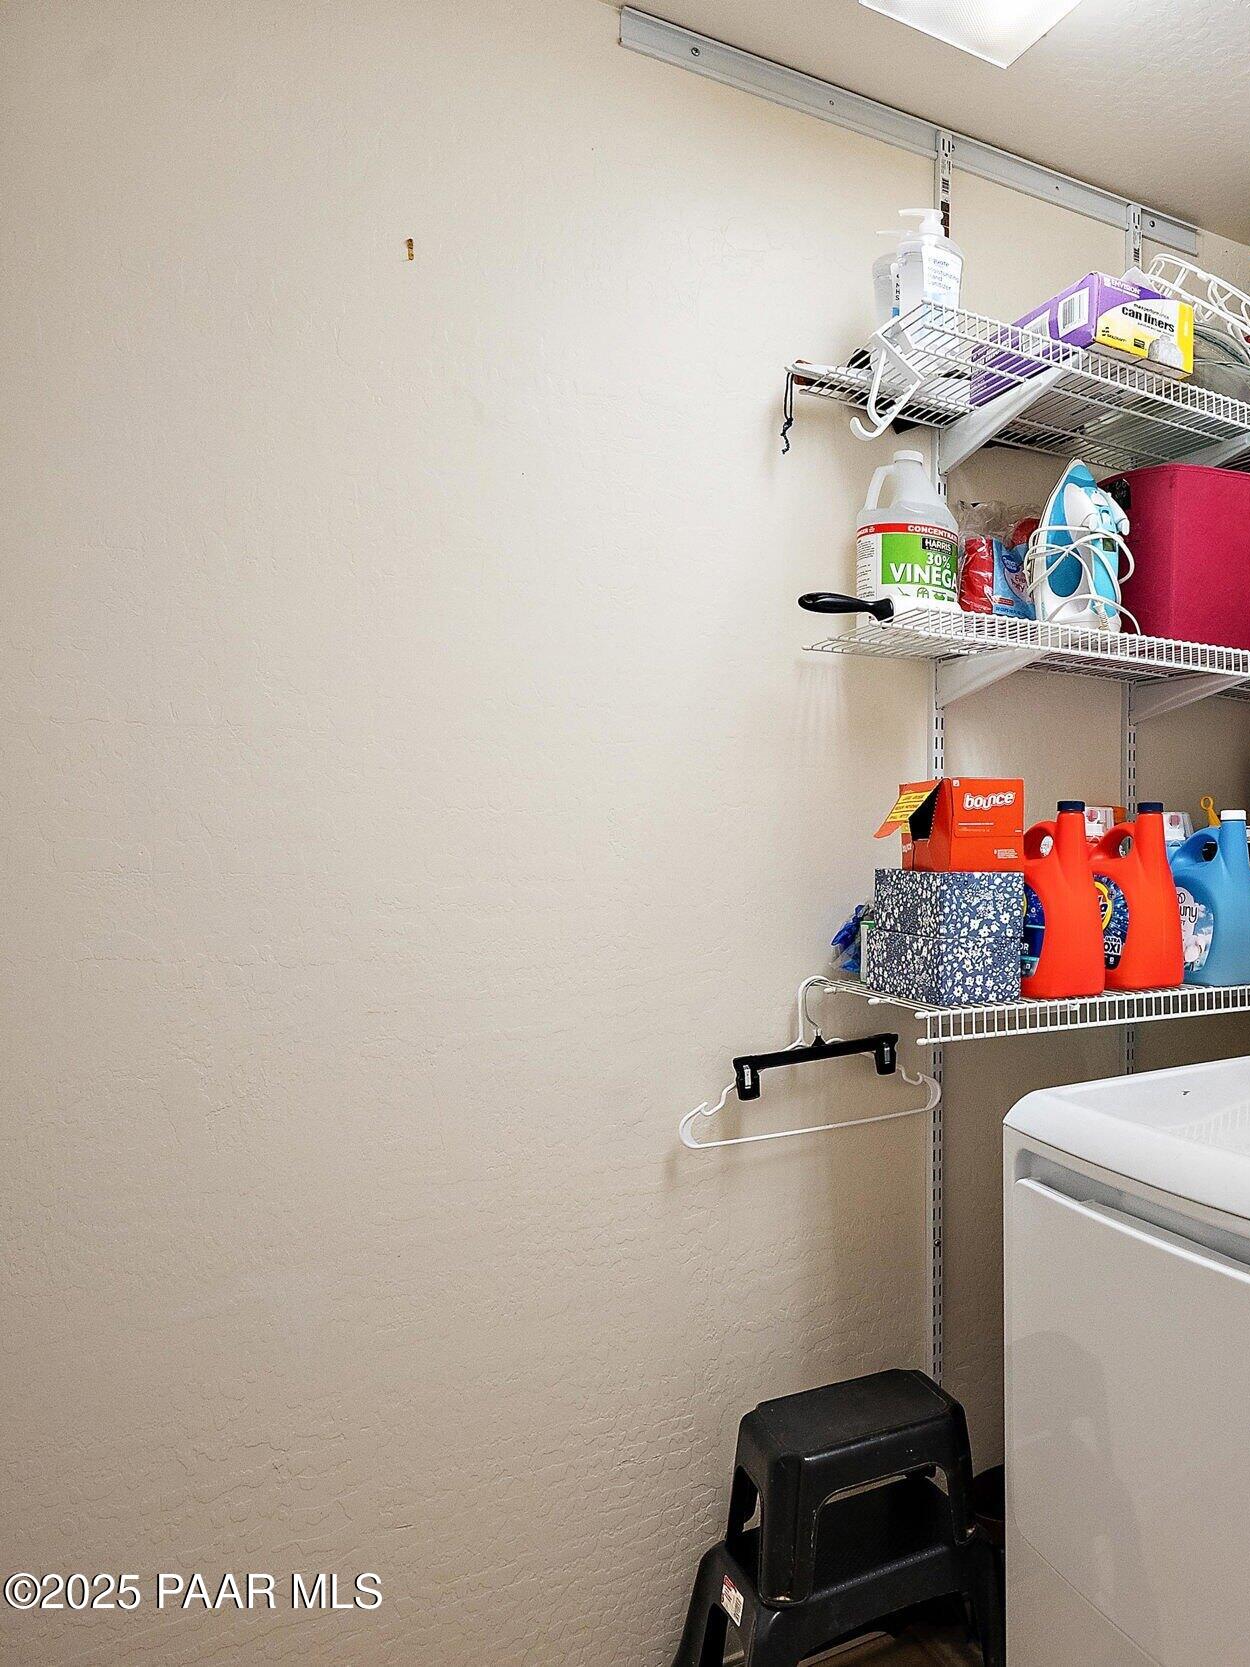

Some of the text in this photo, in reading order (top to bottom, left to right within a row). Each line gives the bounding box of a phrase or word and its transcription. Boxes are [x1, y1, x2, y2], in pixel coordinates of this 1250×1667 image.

[1121, 305, 1142, 321] can
[1144, 312, 1175, 333] liners
[925, 538, 952, 555] HARRIS
[926, 552, 951, 569] 30%
[963, 791, 1016, 810] bounce
[1103, 942, 1121, 954] OXI
